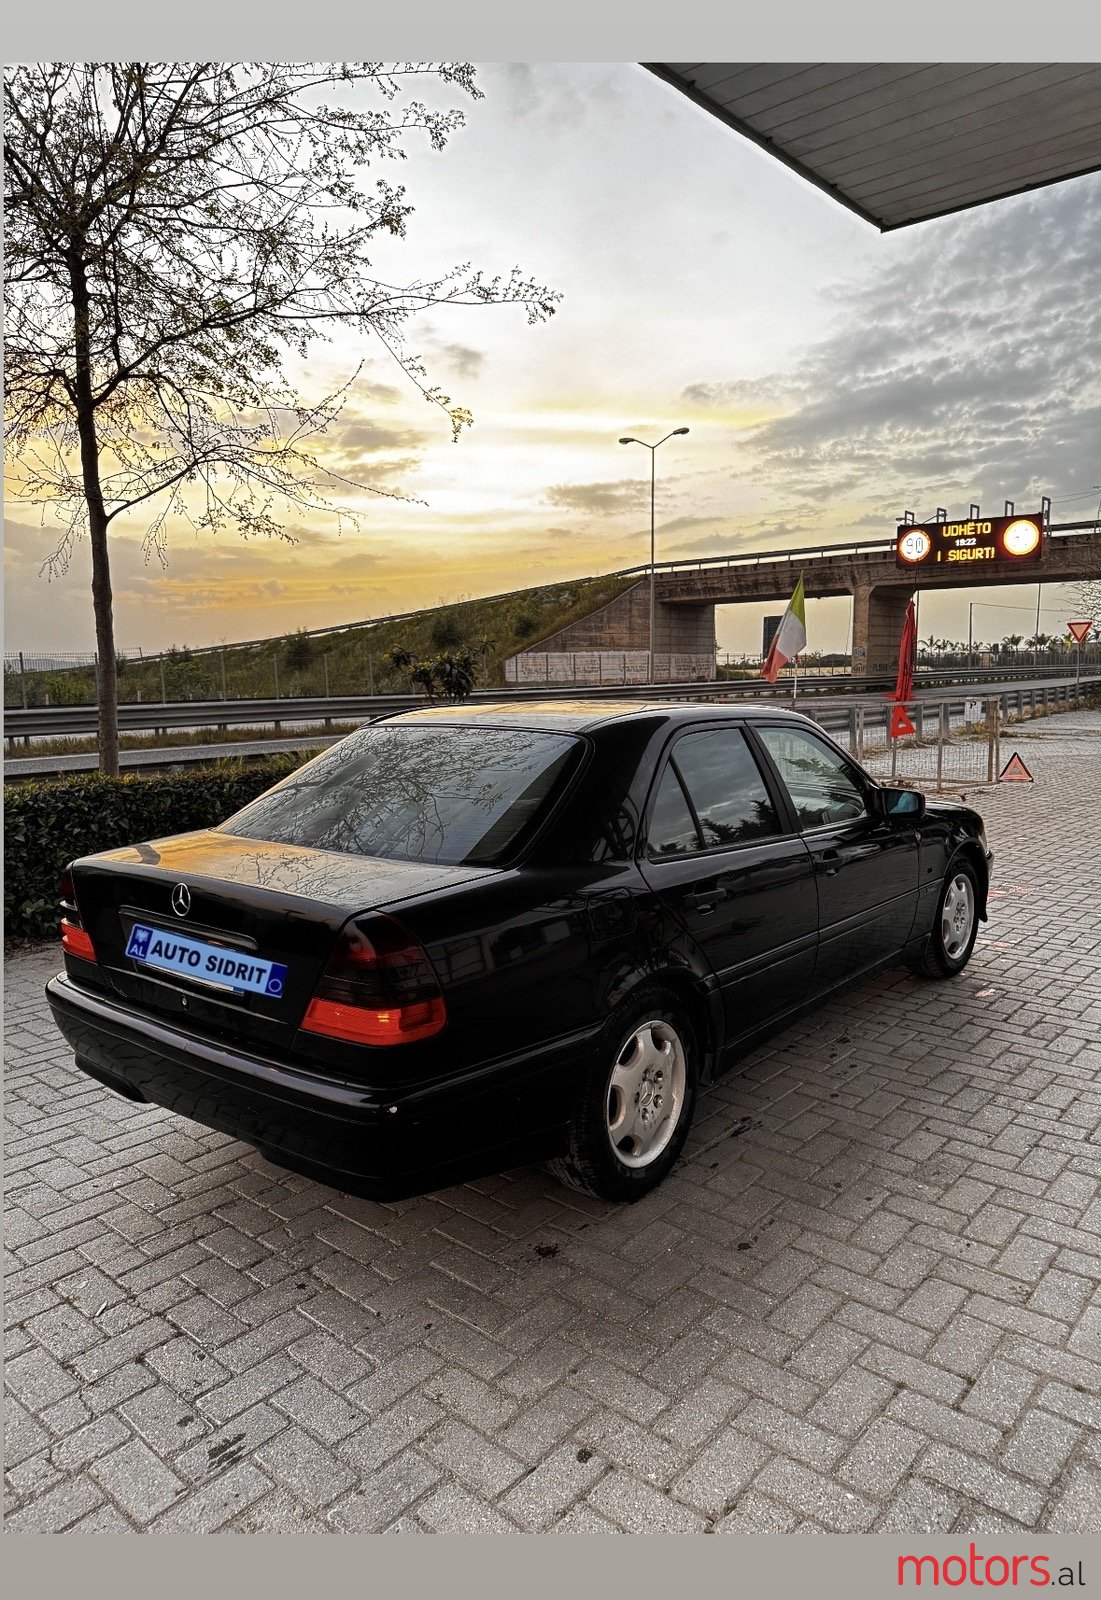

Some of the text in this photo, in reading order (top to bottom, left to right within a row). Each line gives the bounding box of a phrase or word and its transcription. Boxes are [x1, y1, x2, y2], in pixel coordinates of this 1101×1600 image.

[943, 522, 991, 537] UDHËTO
[907, 537, 923, 554] 90
[948, 547, 995, 560] SIGURT!
